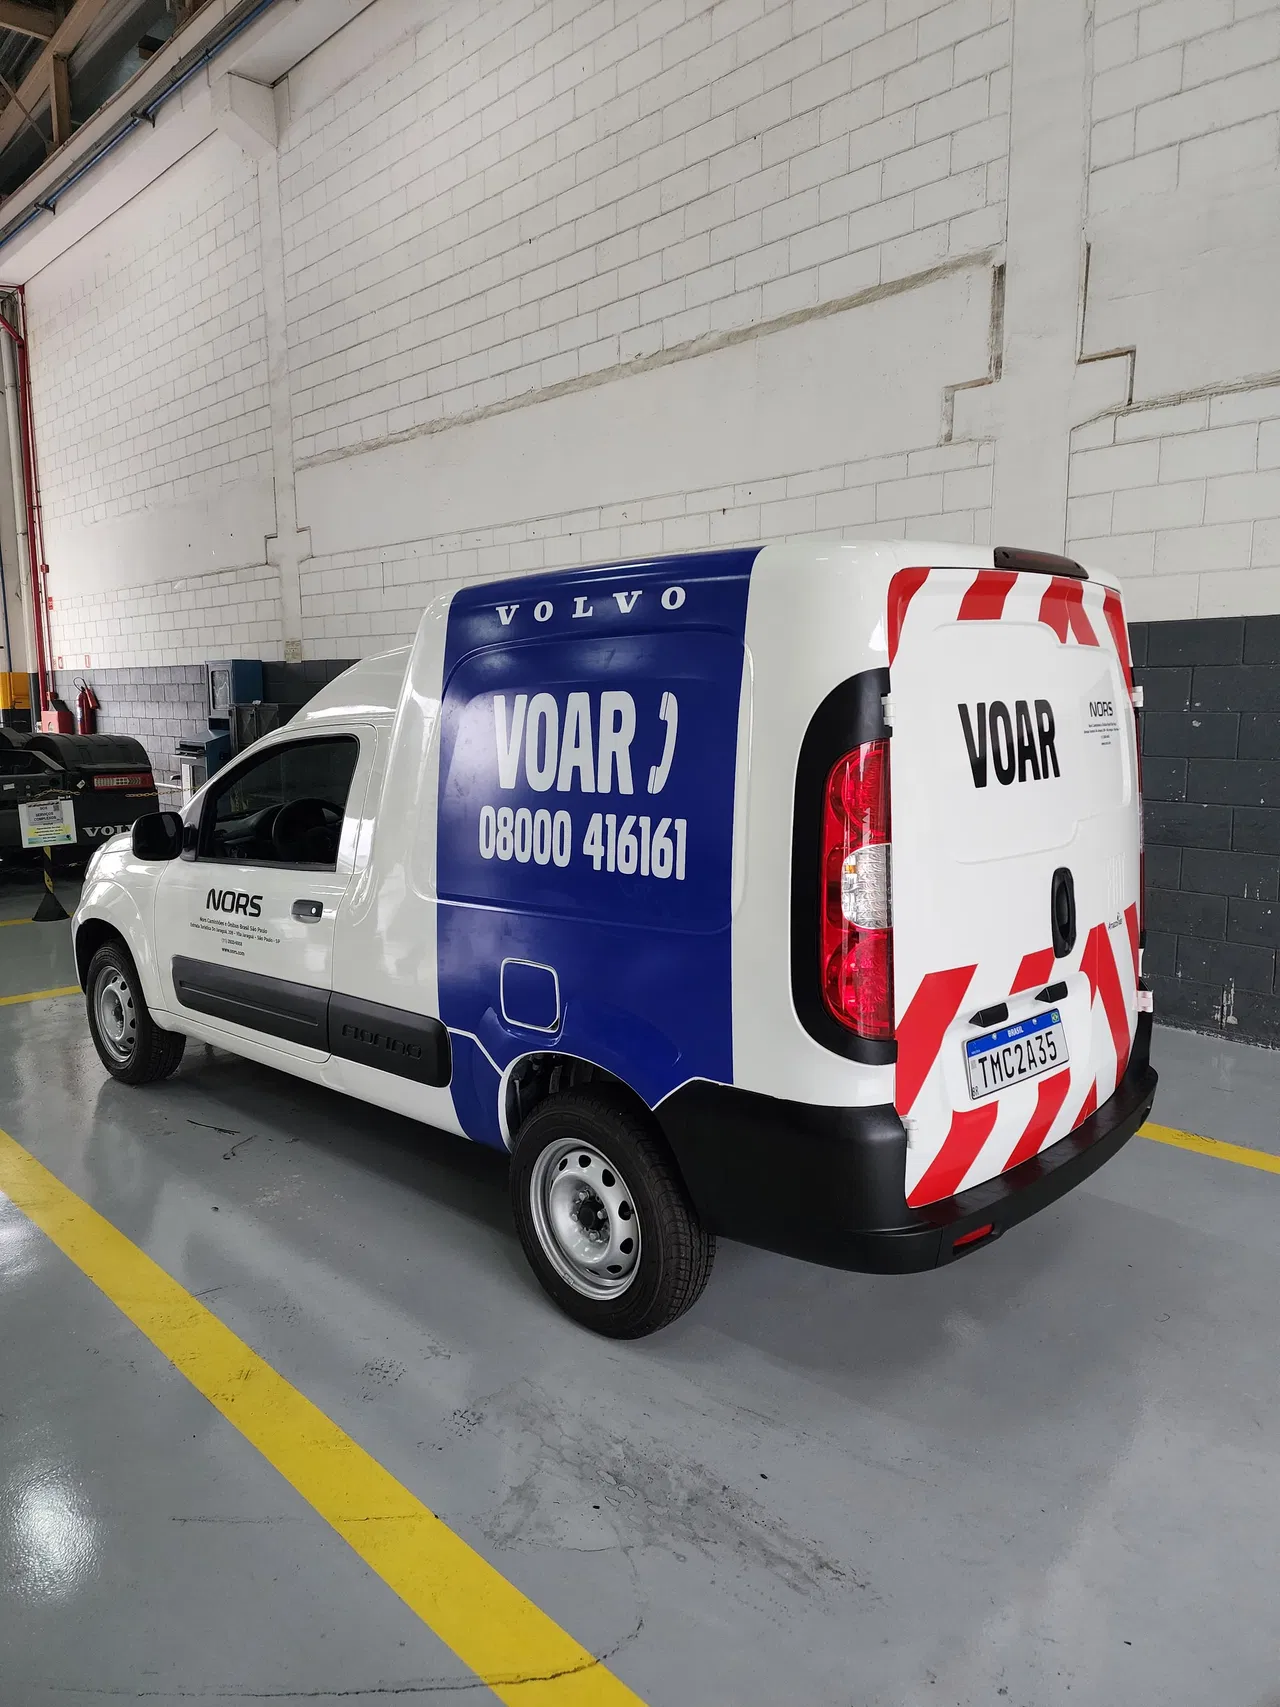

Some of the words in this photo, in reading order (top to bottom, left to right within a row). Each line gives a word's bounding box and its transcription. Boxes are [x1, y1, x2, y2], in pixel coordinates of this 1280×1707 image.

[496, 586, 686, 625] VOLVO
[1089, 701, 1114, 717] NORS
[493, 690, 636, 795] VOAR
[958, 699, 1060, 788] VOAR
[479, 805, 572, 868] 08000
[582, 812, 687, 880] 416161
[206, 888, 264, 918] NORS
[1007, 1026, 1024, 1038] BRASIL
[978, 1030, 1057, 1088] TMC2A35
[972, 1086, 979, 1097] BR
